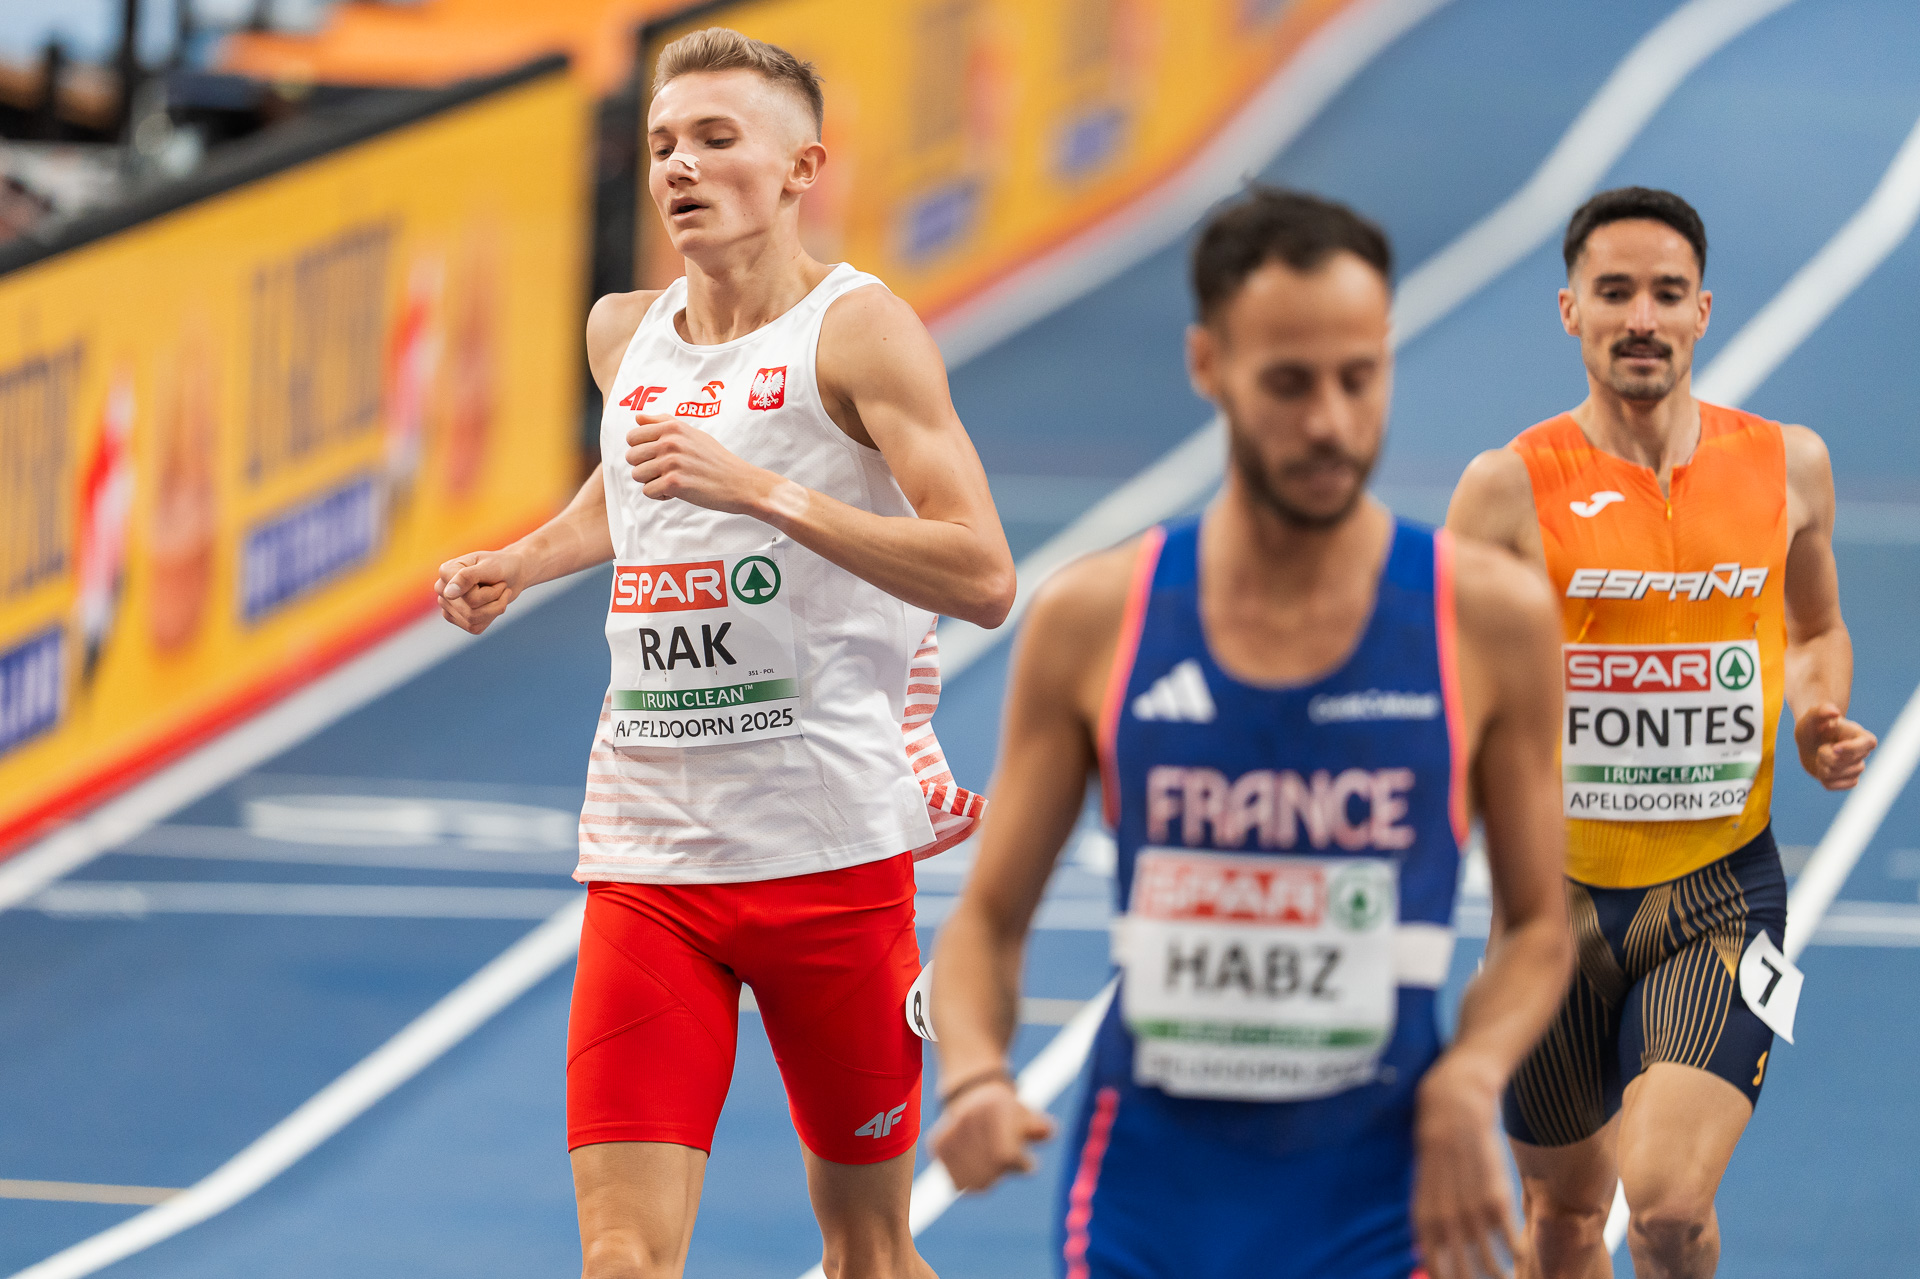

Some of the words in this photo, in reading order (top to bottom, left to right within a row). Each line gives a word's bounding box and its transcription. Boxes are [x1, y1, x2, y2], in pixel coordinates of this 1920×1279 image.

[619, 385, 667, 411] 4F
[677, 402, 719, 416] ORLEN
[615, 568, 723, 606] SPAR
[1566, 562, 1769, 600] ESPAÑA
[639, 622, 737, 670] RAK
[1568, 654, 1709, 688] SPAR
[642, 693, 646, 708] I
[648, 693, 679, 708] RUN
[615, 716, 735, 738] APELDOORN
[740, 708, 793, 732] 2025
[1568, 704, 1755, 747] FONTES
[1613, 768, 1652, 784] RUN
[1147, 766, 1415, 850] FRANCE
[1570, 791, 1702, 811] APELDOORN
[1709, 788, 1749, 808] 202
[1165, 942, 1341, 999] HABZ
[1758, 955, 1783, 1008] 7
[854, 1101, 907, 1139] 4F
